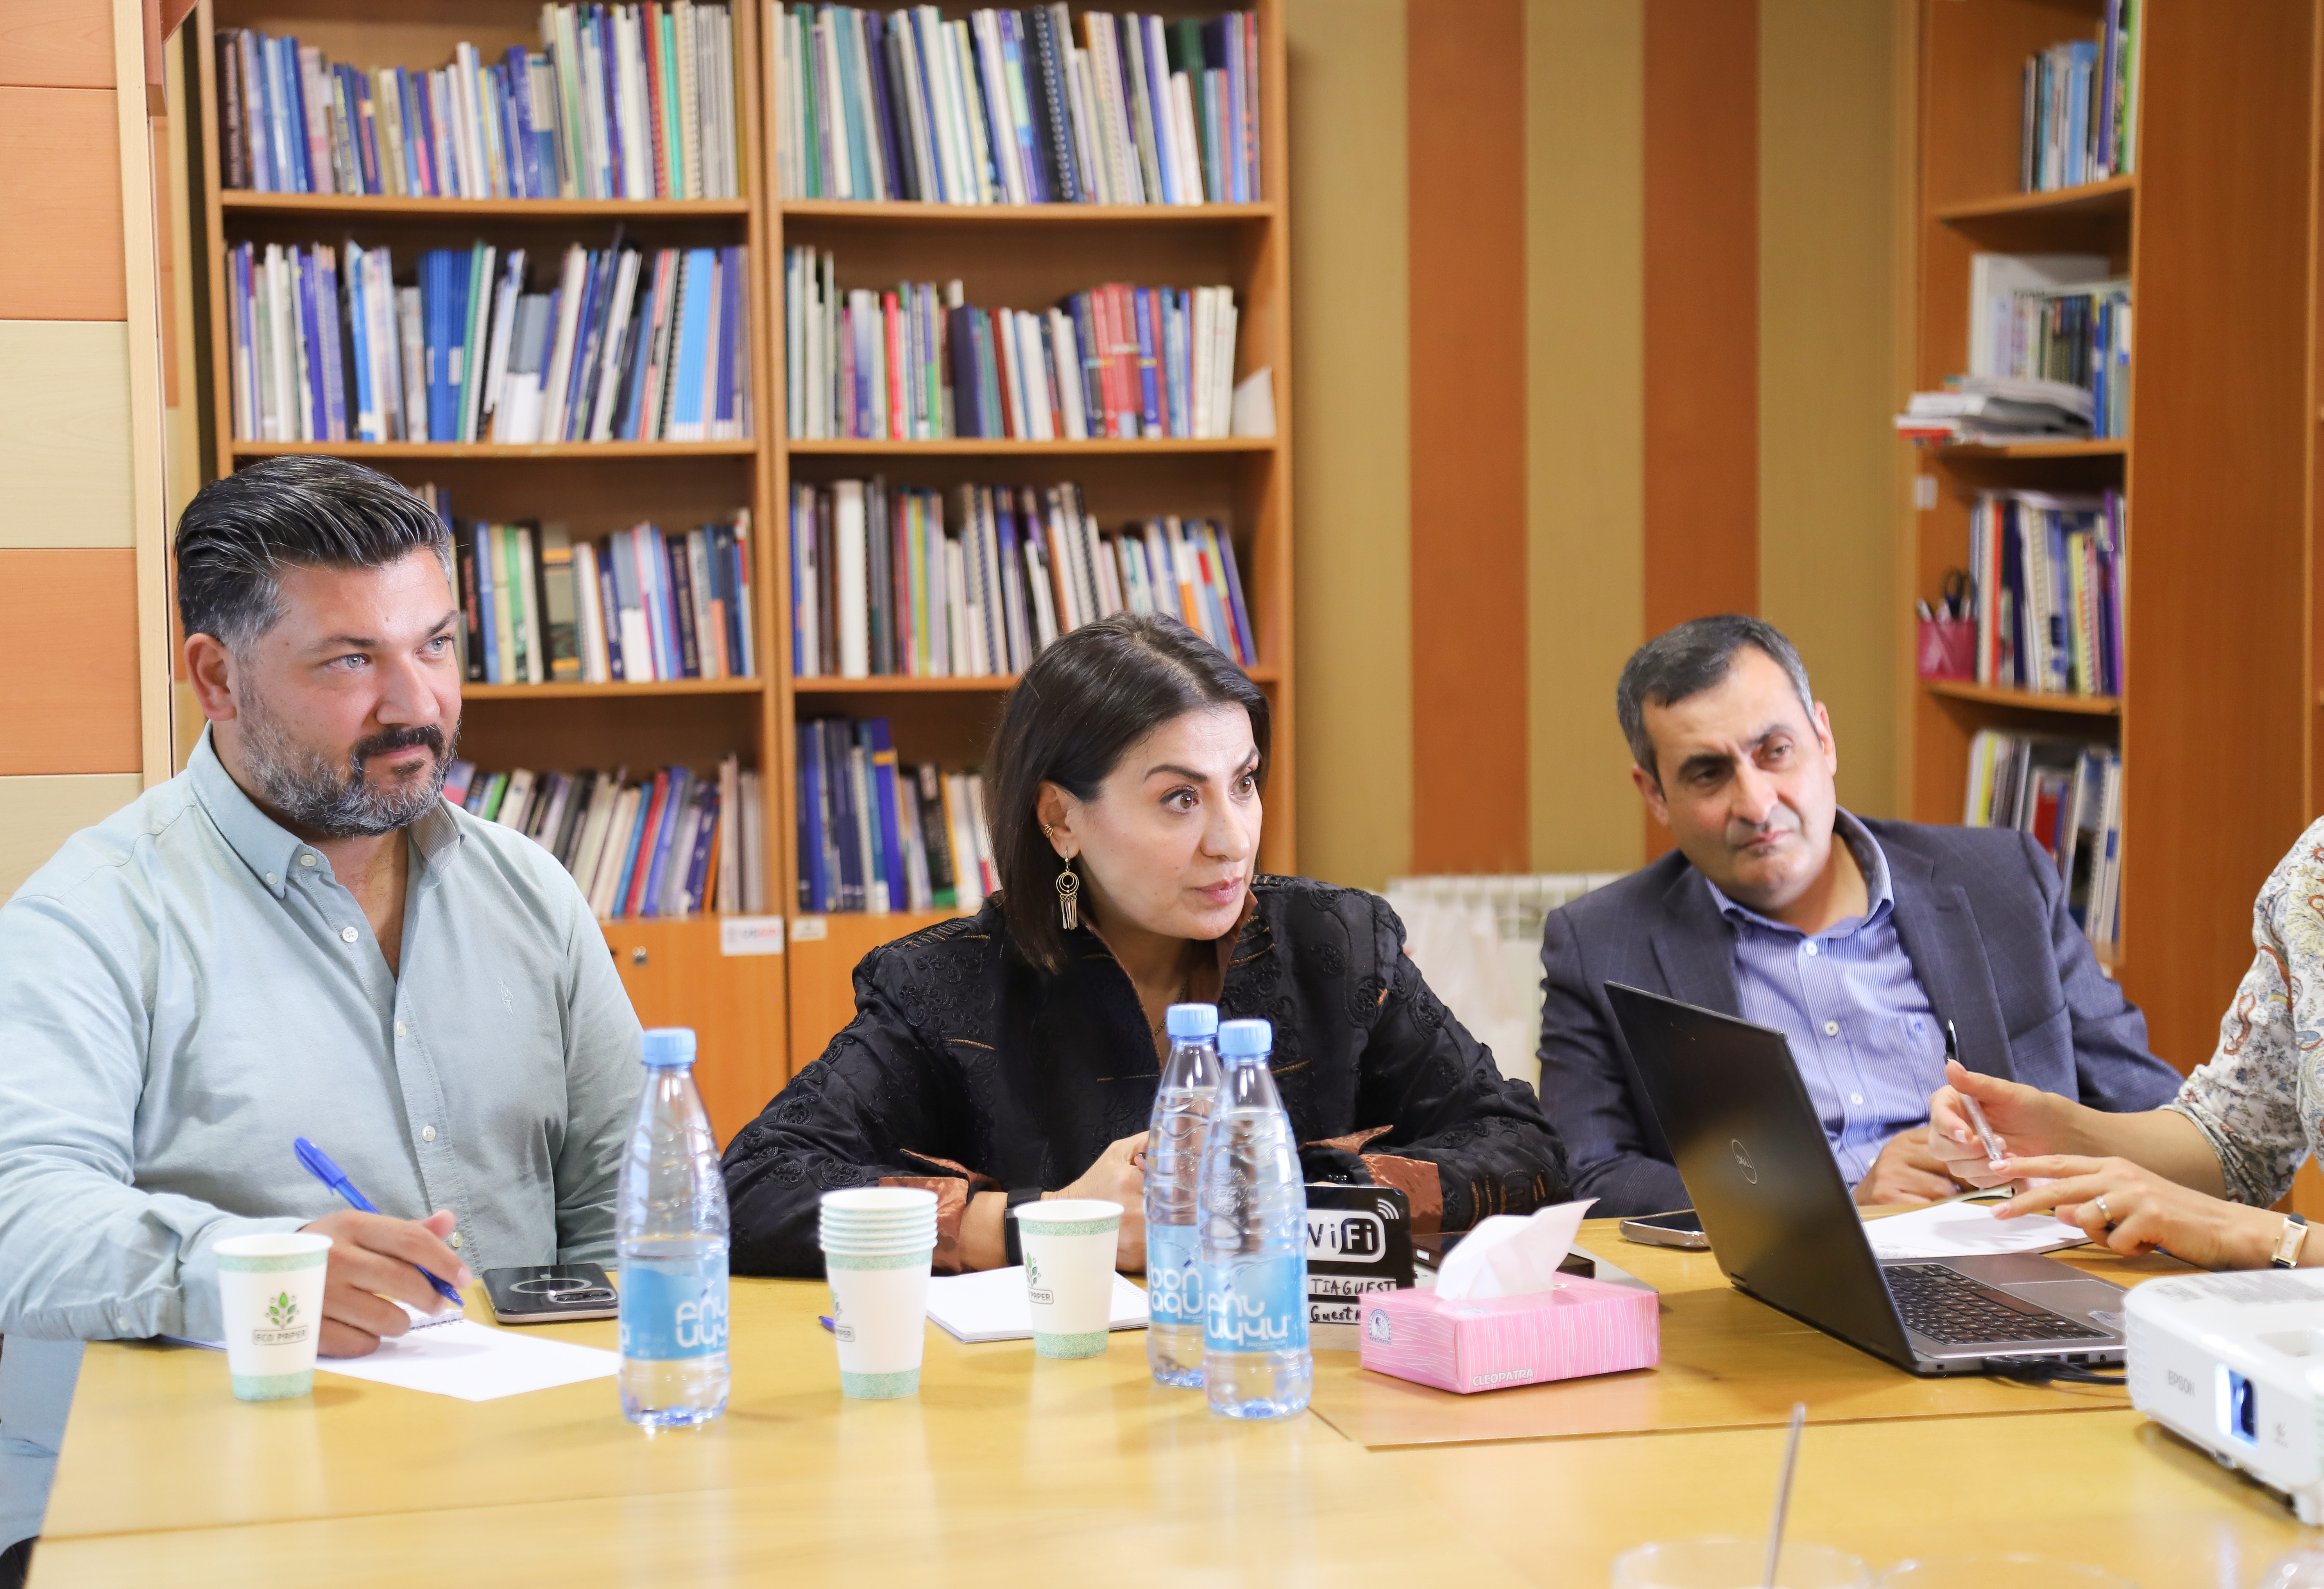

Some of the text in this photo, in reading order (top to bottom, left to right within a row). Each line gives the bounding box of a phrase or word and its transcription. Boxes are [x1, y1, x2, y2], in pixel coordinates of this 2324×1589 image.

[1152, 1290, 1203, 1319] aqu
[1473, 1368, 1534, 1387] CLEOPATRA
[2168, 1369, 2195, 1397] EPSON
